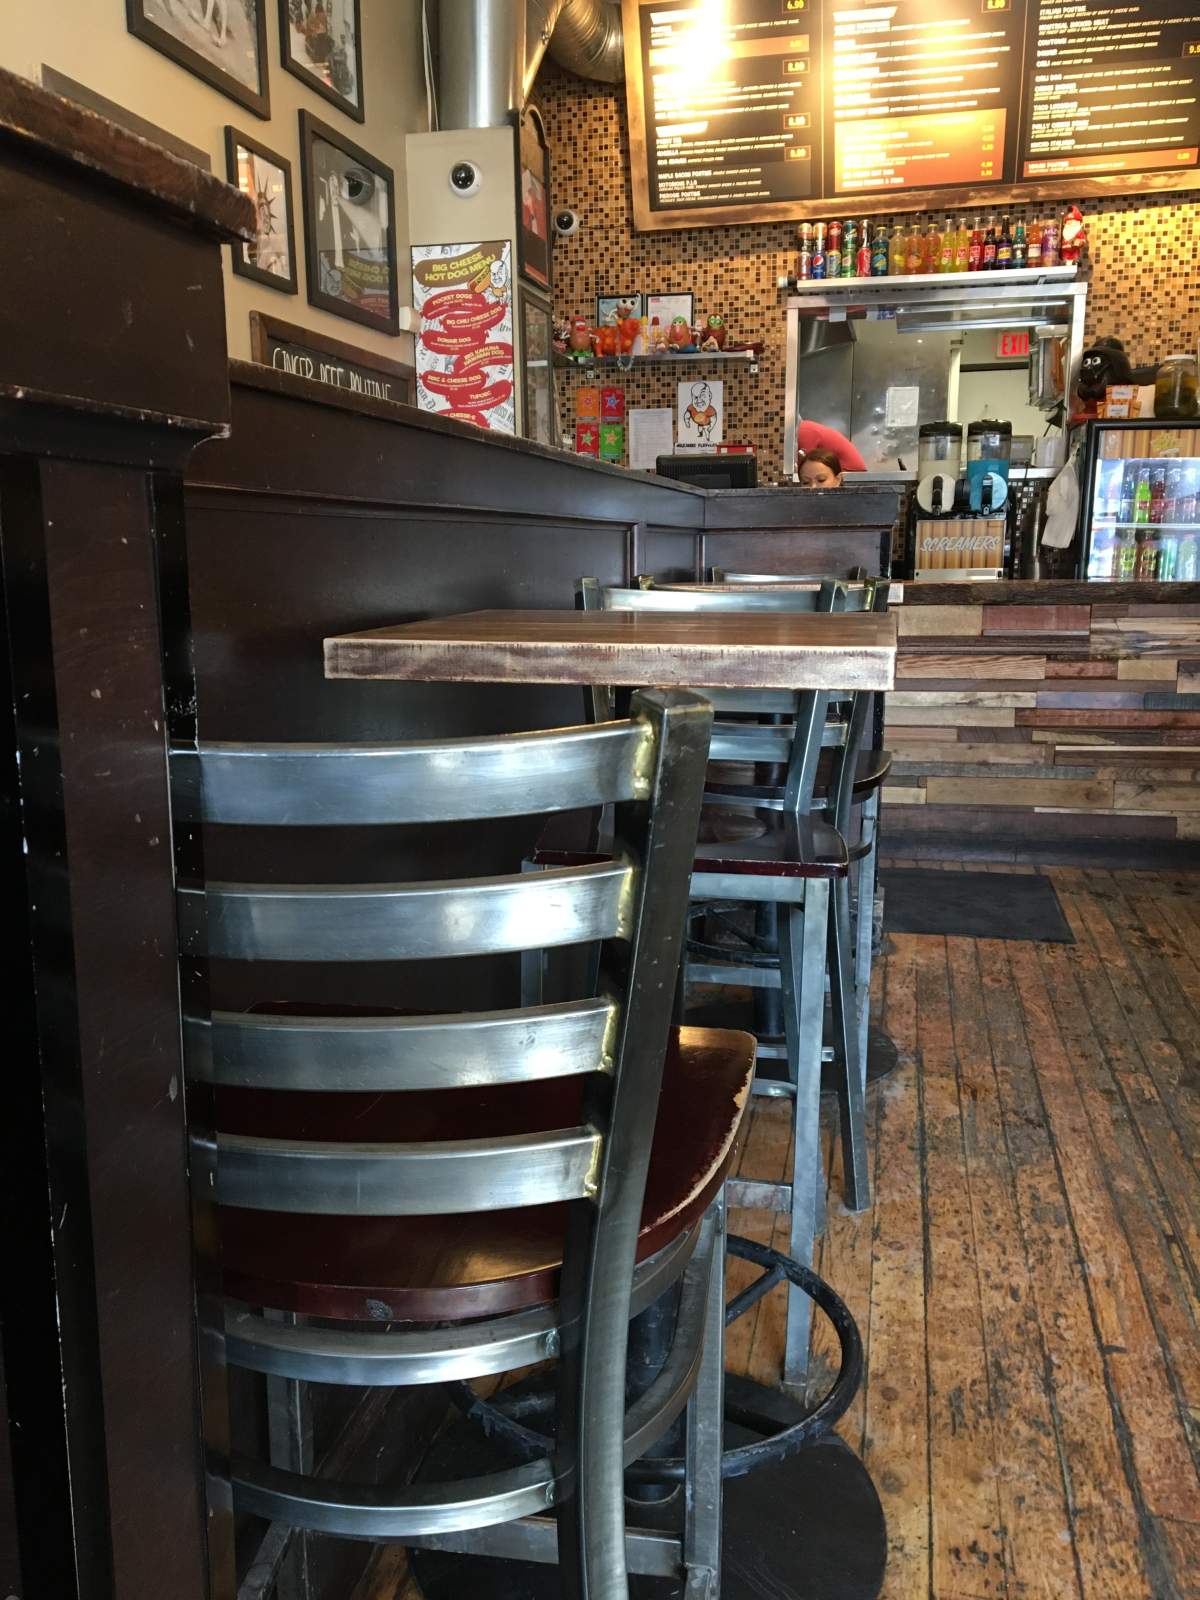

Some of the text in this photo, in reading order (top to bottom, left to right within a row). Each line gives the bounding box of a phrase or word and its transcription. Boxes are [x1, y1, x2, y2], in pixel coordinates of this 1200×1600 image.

[425, 254, 496, 281] HOT DOG MENU
[432, 251, 483, 272] BIG CHEESE
[920, 536, 1001, 552] SCREAMERS
